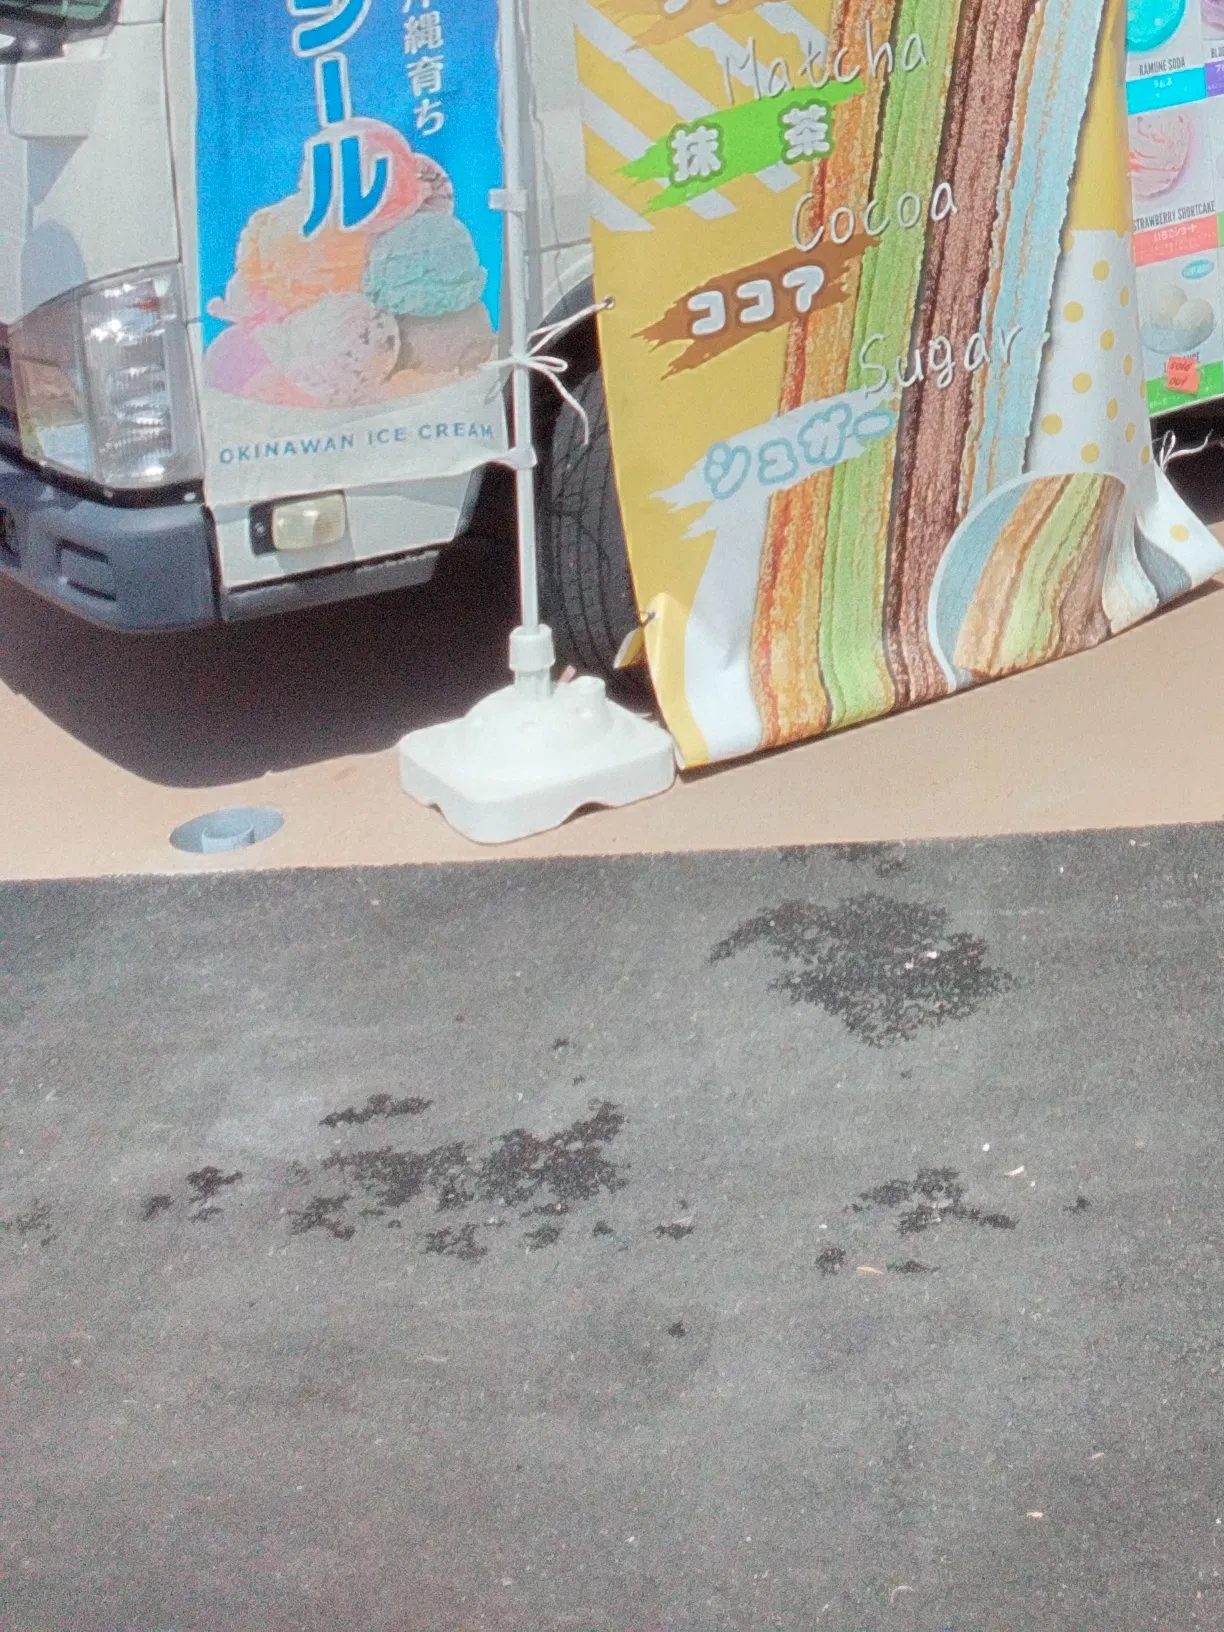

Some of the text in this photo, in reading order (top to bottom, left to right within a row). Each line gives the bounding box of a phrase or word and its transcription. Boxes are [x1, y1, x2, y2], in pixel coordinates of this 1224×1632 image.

[722, 18, 928, 104] Matcha
[1139, 56, 1186, 76] RAMUNE SODA
[670, 102, 831, 182] 抹茶
[791, 181, 959, 252] Cocoa
[1133, 209, 1177, 232] STRAWBERRY
[1177, 200, 1216, 220] SHORTCAKE
[686, 264, 825, 336] ココア
[857, 324, 1025, 400] Sugar
[219, 421, 494, 465] OKINAWAN ICE CREAM
[703, 400, 895, 501] シュガー
